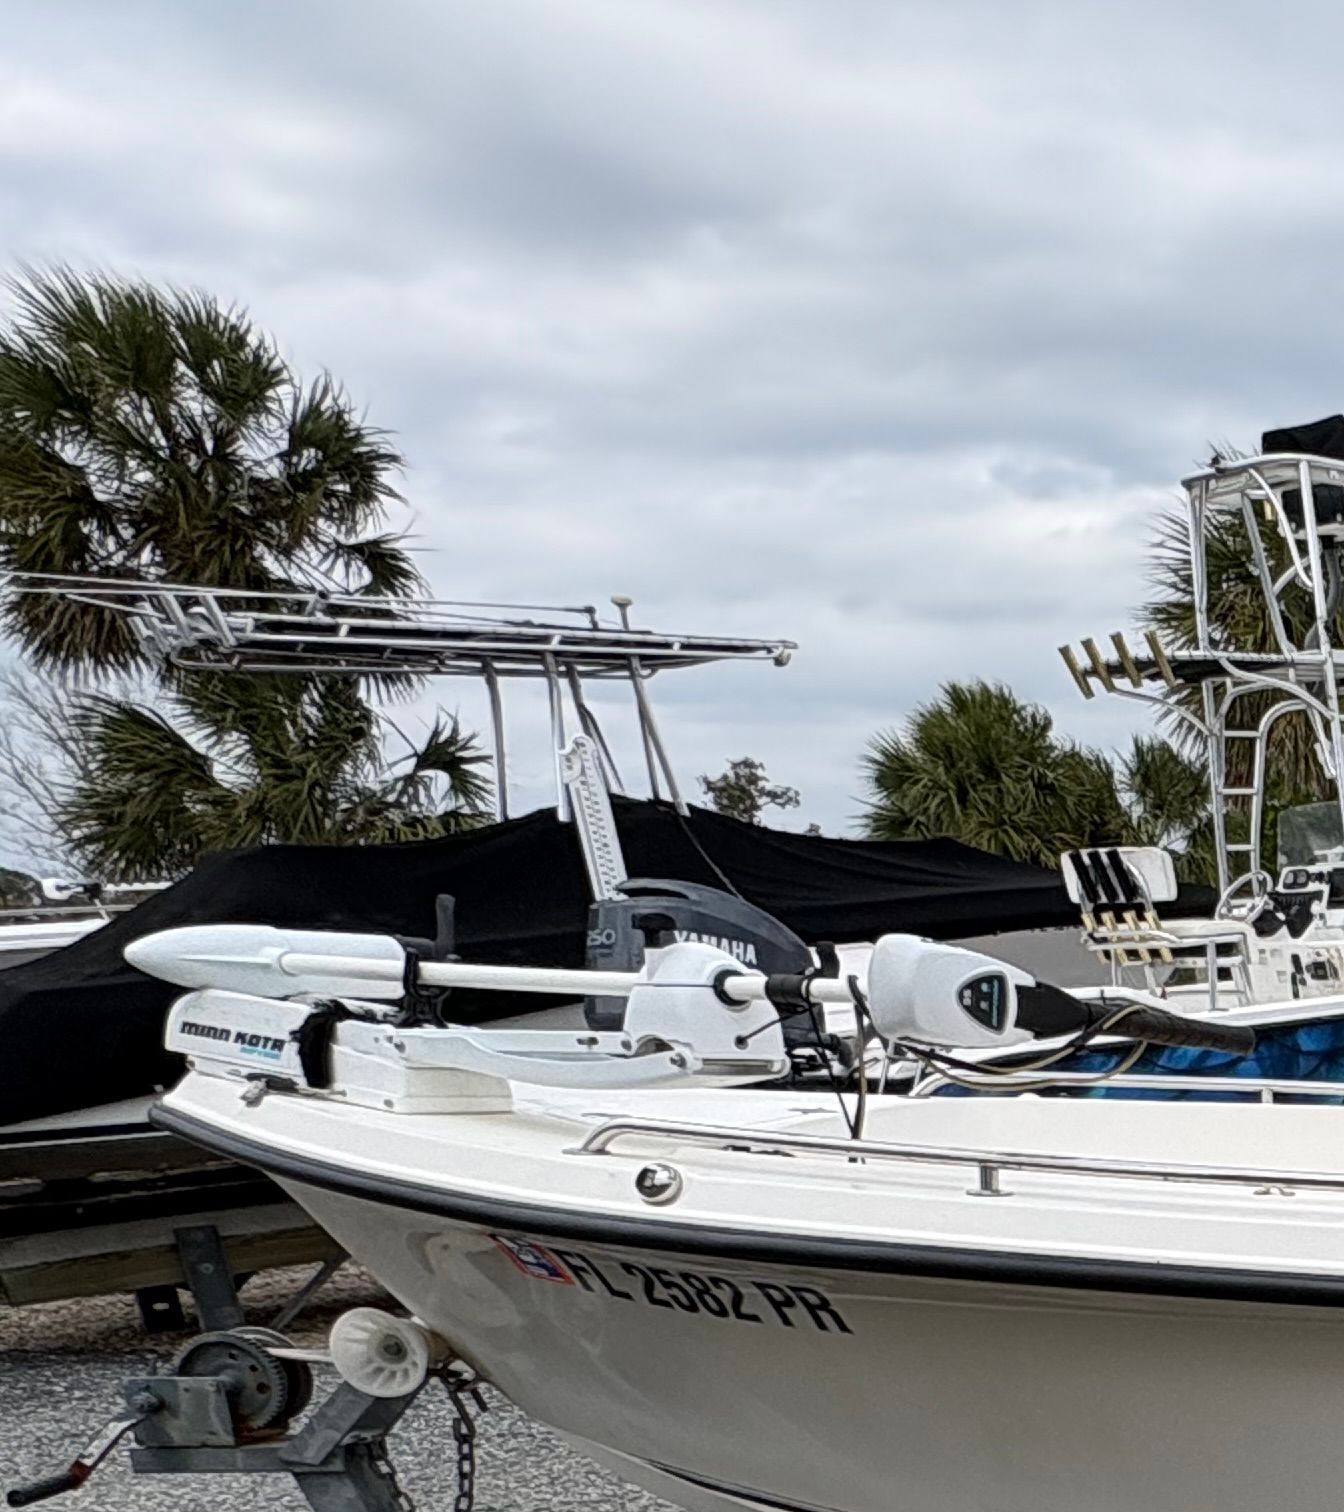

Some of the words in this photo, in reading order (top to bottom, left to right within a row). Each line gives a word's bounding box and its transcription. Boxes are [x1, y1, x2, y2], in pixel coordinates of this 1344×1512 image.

[548, 1247, 636, 1303] FL
[620, 1262, 764, 1324] 2582
[750, 1280, 854, 1336] PR
